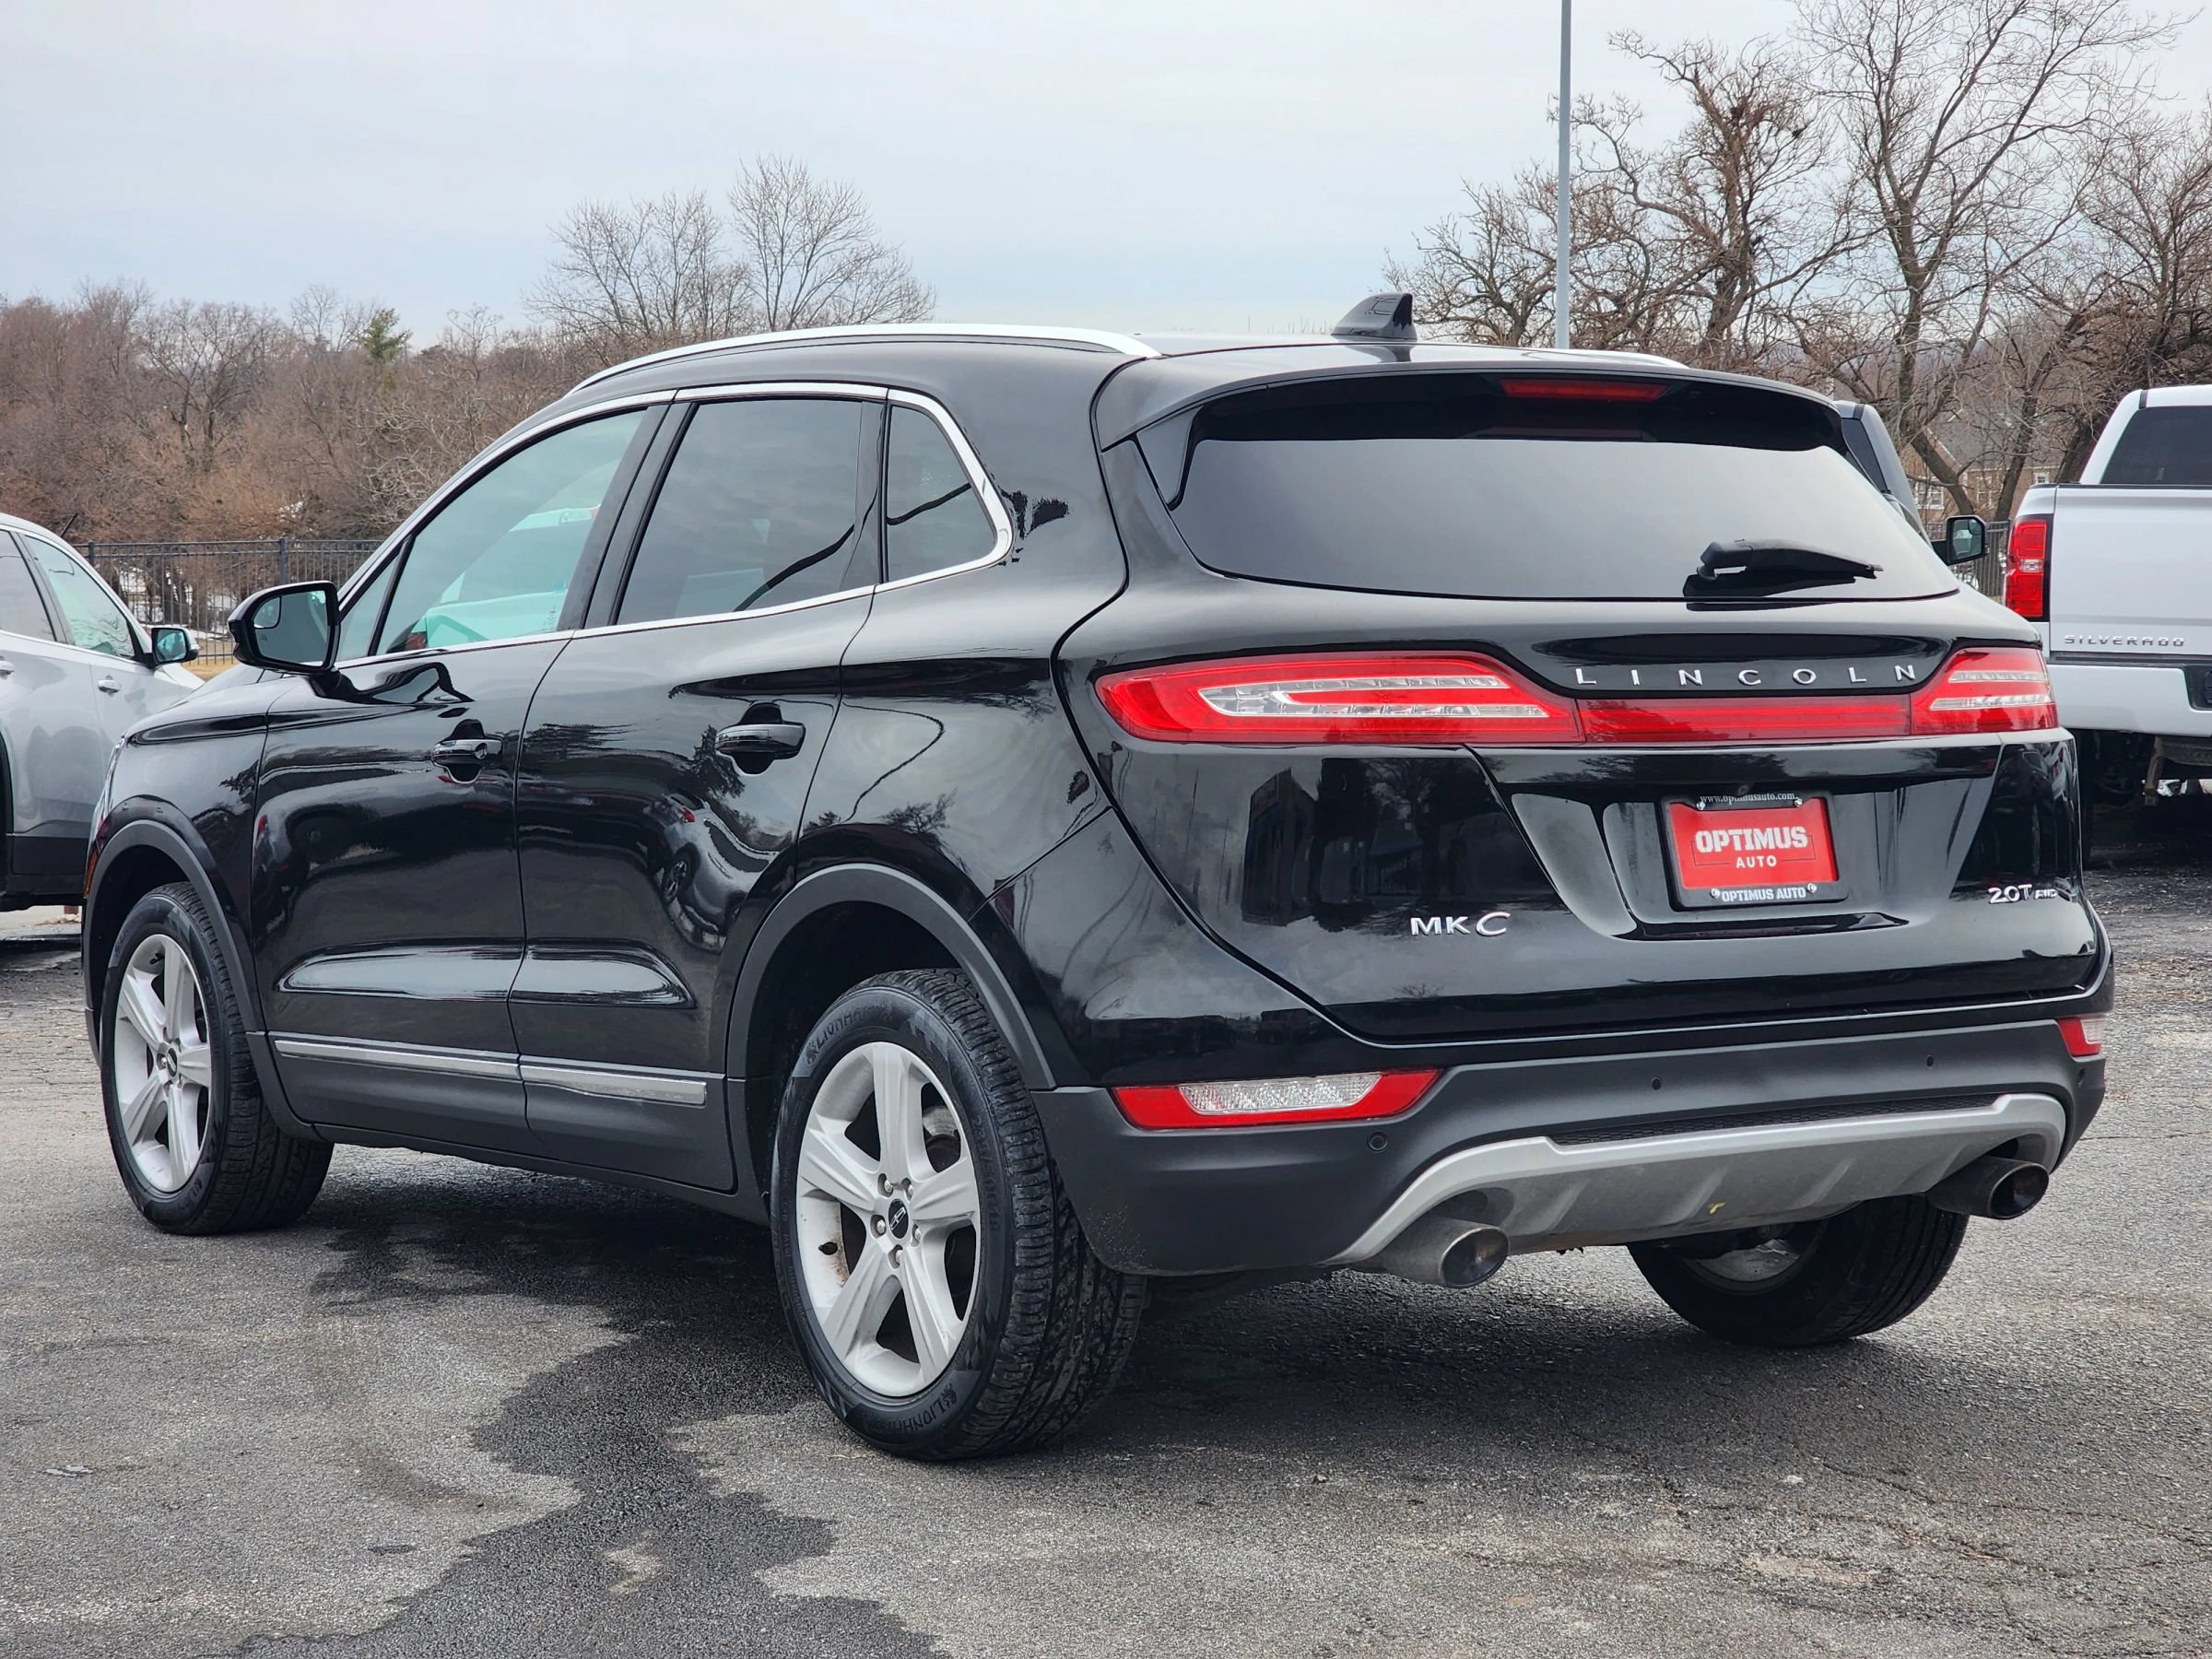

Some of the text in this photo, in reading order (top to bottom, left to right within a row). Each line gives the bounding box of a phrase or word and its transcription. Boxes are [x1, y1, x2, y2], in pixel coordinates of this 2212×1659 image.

[2065, 634, 2184, 647] SILVERADO
[1575, 665, 1916, 686] LINCOLN
[1696, 826, 1808, 853] OPTIMUS
[1736, 855, 1777, 869] AUTO
[1722, 887, 1806, 902] OPTIMUS AUTO
[1410, 912, 1511, 936] MKC
